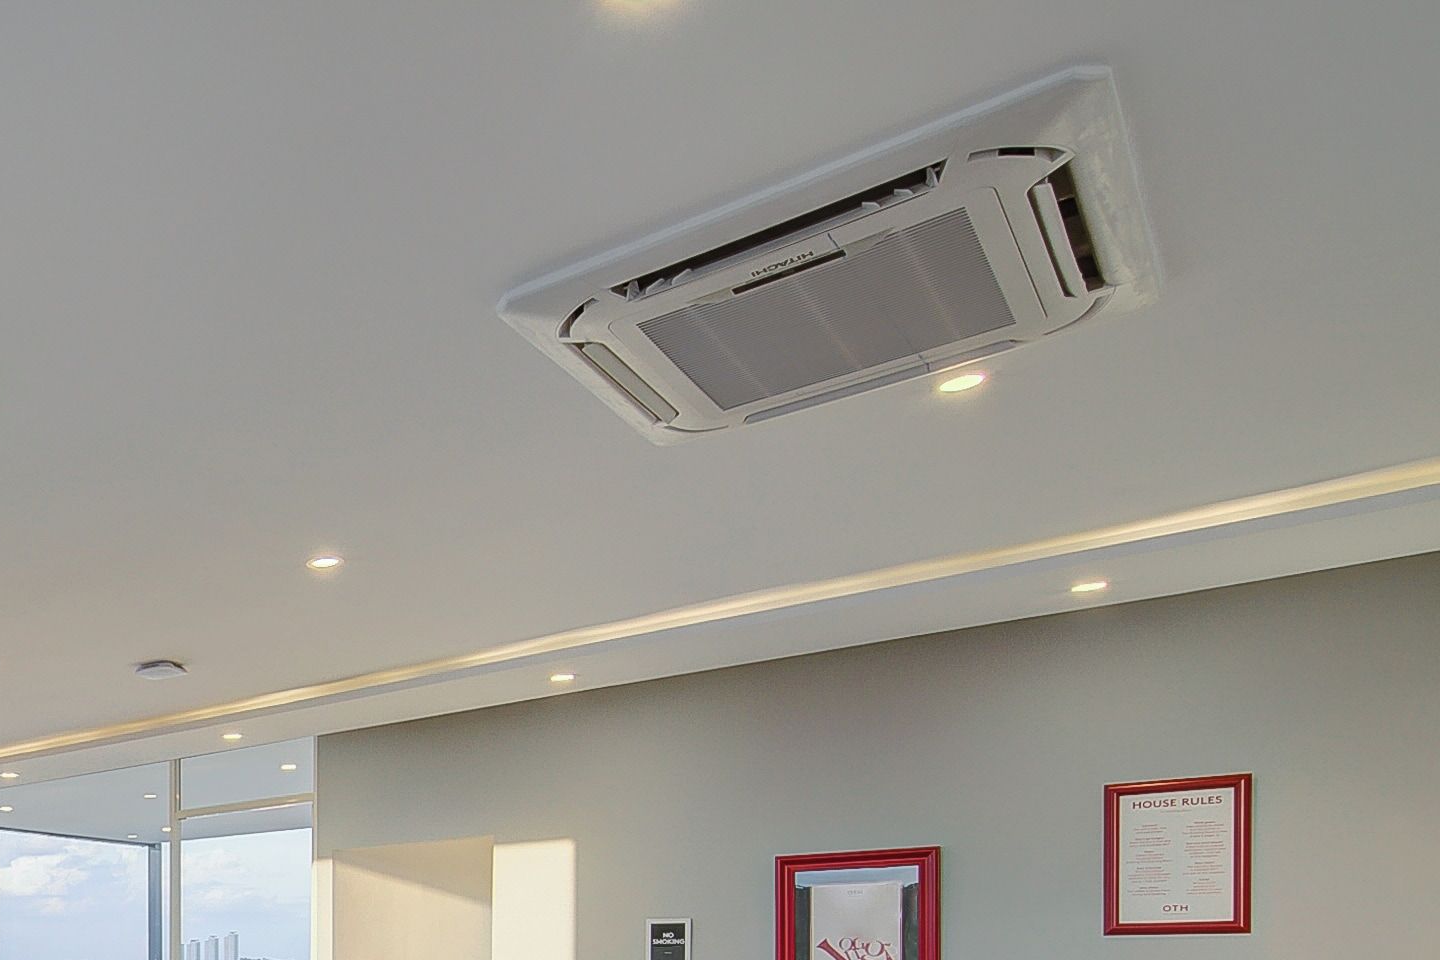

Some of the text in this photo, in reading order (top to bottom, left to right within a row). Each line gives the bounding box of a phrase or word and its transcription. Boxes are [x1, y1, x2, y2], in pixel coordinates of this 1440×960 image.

[751, 251, 814, 277] HITACHI
[1132, 795, 1223, 810] HOUSE RULES
[1162, 904, 1189, 912] OTH
